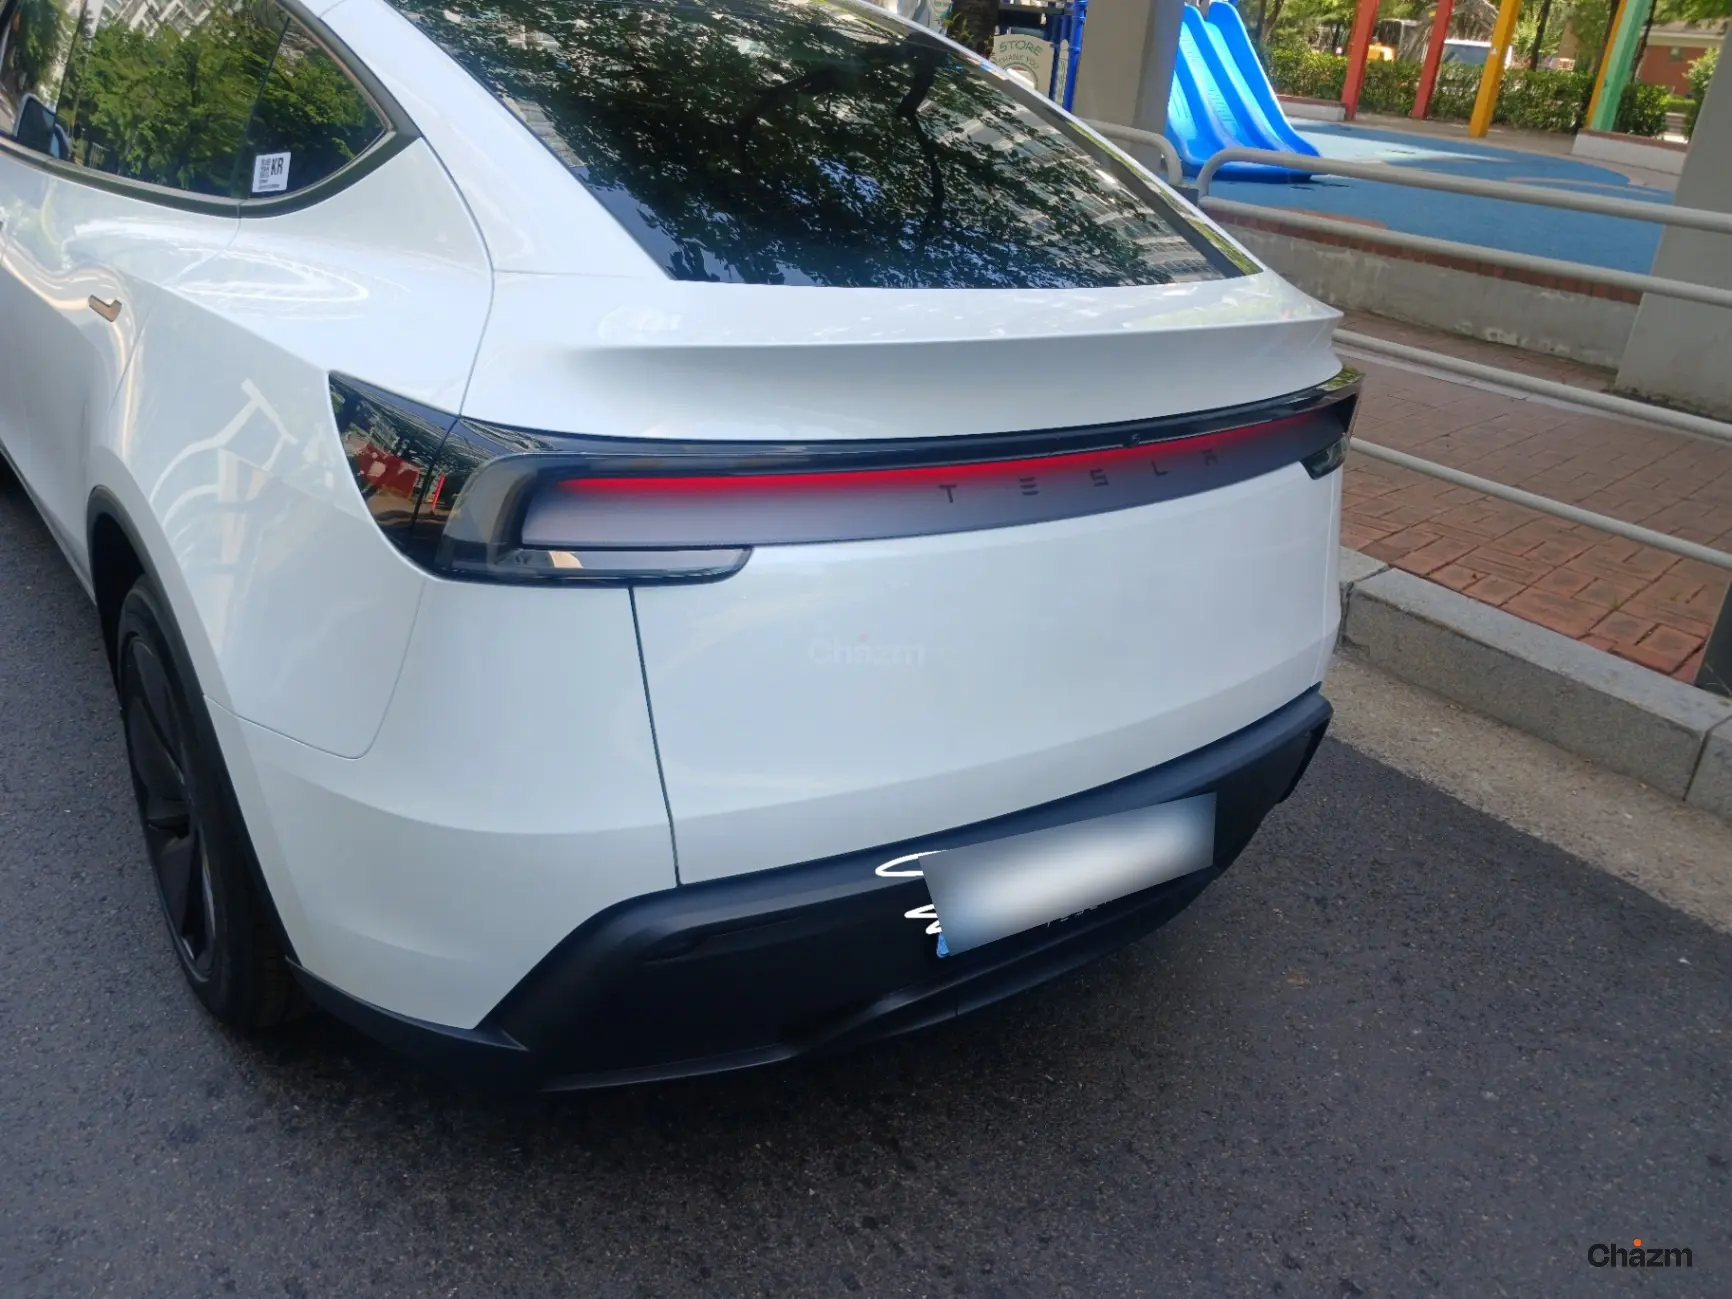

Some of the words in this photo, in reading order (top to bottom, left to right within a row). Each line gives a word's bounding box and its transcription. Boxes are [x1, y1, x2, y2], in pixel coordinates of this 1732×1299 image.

[999, 39, 1043, 57] STORE
[270, 157, 284, 176] KR
[938, 448, 1220, 504] TESLA
